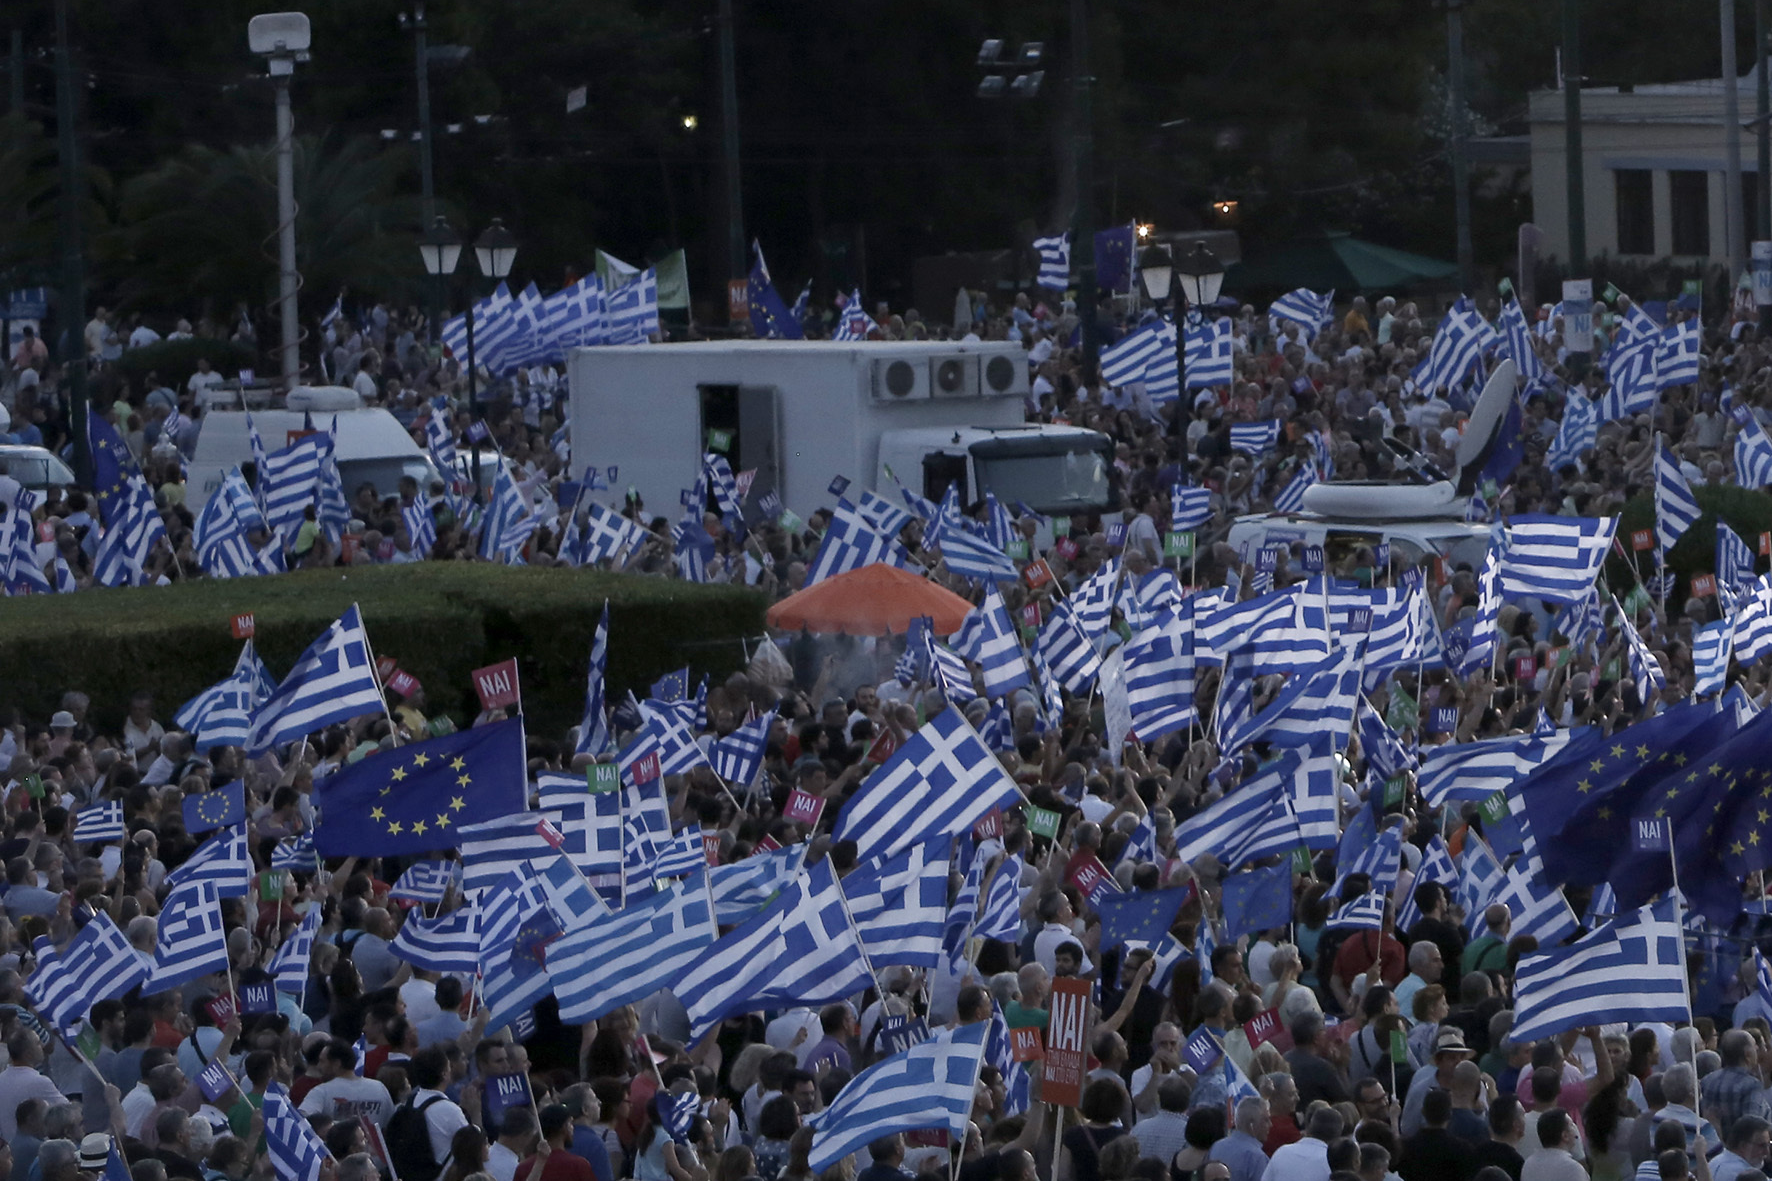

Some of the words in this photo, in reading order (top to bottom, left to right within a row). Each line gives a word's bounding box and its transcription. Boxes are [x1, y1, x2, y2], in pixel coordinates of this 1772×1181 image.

[732, 287, 748, 303] ΝΑ
[1173, 534, 1189, 547] ΝΑΙ
[1634, 532, 1649, 542] ΝΑΙ
[1261, 551, 1276, 563] ΝΑΙ
[1306, 550, 1320, 563] ΝΑΙ
[1027, 564, 1042, 577] ΝΑΙ
[1403, 571, 1416, 583] ΝΑΙ
[238, 614, 253, 628] ΝΑΙ
[1353, 610, 1368, 624] ΝΑΙ
[1448, 644, 1463, 658] ΝΑΙ
[1520, 659, 1532, 670] ΝΑΙ
[396, 673, 413, 688] ΝΑΙ
[479, 670, 510, 697] ΝΑΙ
[1438, 709, 1455, 722] ΝΑΙ
[596, 767, 615, 781] ΝΑΙ
[640, 757, 654, 775] ΝΑΙ
[794, 795, 816, 813] ΝΑΙ
[1485, 794, 1503, 813] ΝΑΙ
[978, 816, 995, 837] ΝΑΙ
[1035, 810, 1053, 827] ΝΑΙ
[1639, 821, 1660, 839] ΝΑΙ
[1292, 850, 1303, 863] ΑΙ
[1078, 865, 1098, 885] ΝΑΙ
[1090, 884, 1108, 906] ΝΑΙ
[247, 987, 267, 1002] ΝΑΙ
[212, 997, 233, 1015] ΝΑΙ
[888, 1018, 902, 1029] ΝΑΙ
[1049, 991, 1086, 1052] ΝΑΙ
[1252, 1012, 1273, 1034] ΝΑΙ
[892, 1026, 923, 1053] ΝΑΙ
[1190, 1036, 1211, 1058] ΝΑΙ
[201, 1064, 222, 1086] ΝΑΙ
[498, 1076, 523, 1095] ΝΑΙ
